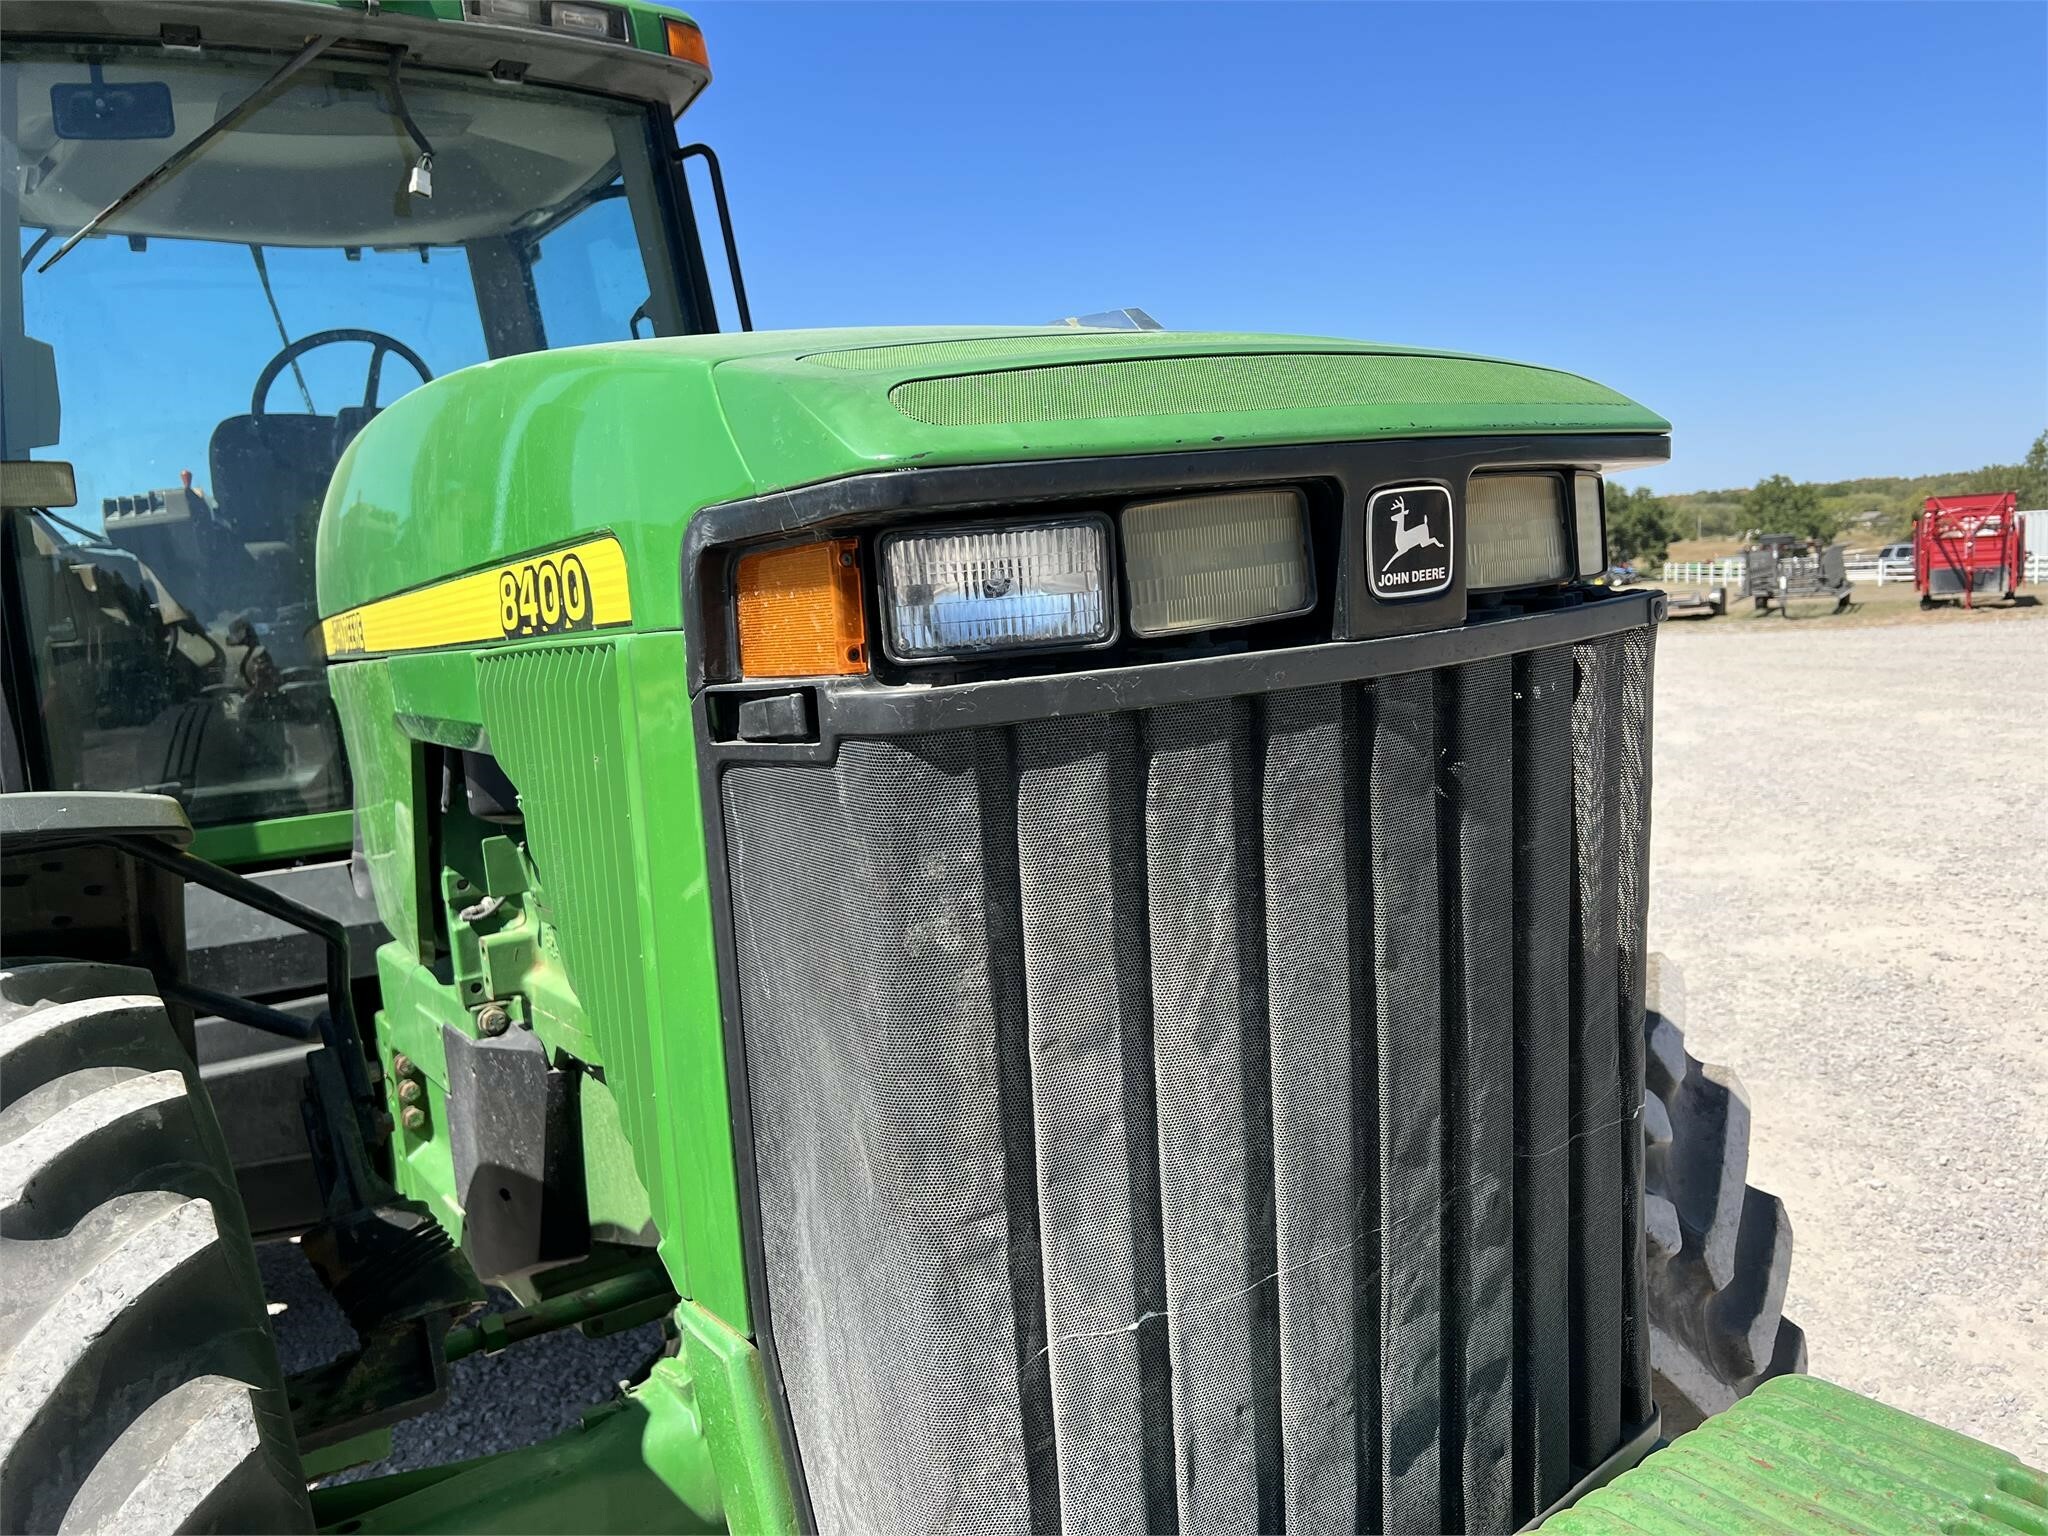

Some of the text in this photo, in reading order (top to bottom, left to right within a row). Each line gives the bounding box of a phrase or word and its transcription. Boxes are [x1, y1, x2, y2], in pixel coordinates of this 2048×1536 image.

[500, 553, 593, 640] 8400
[1378, 567, 1445, 587] JOHN DEERE
